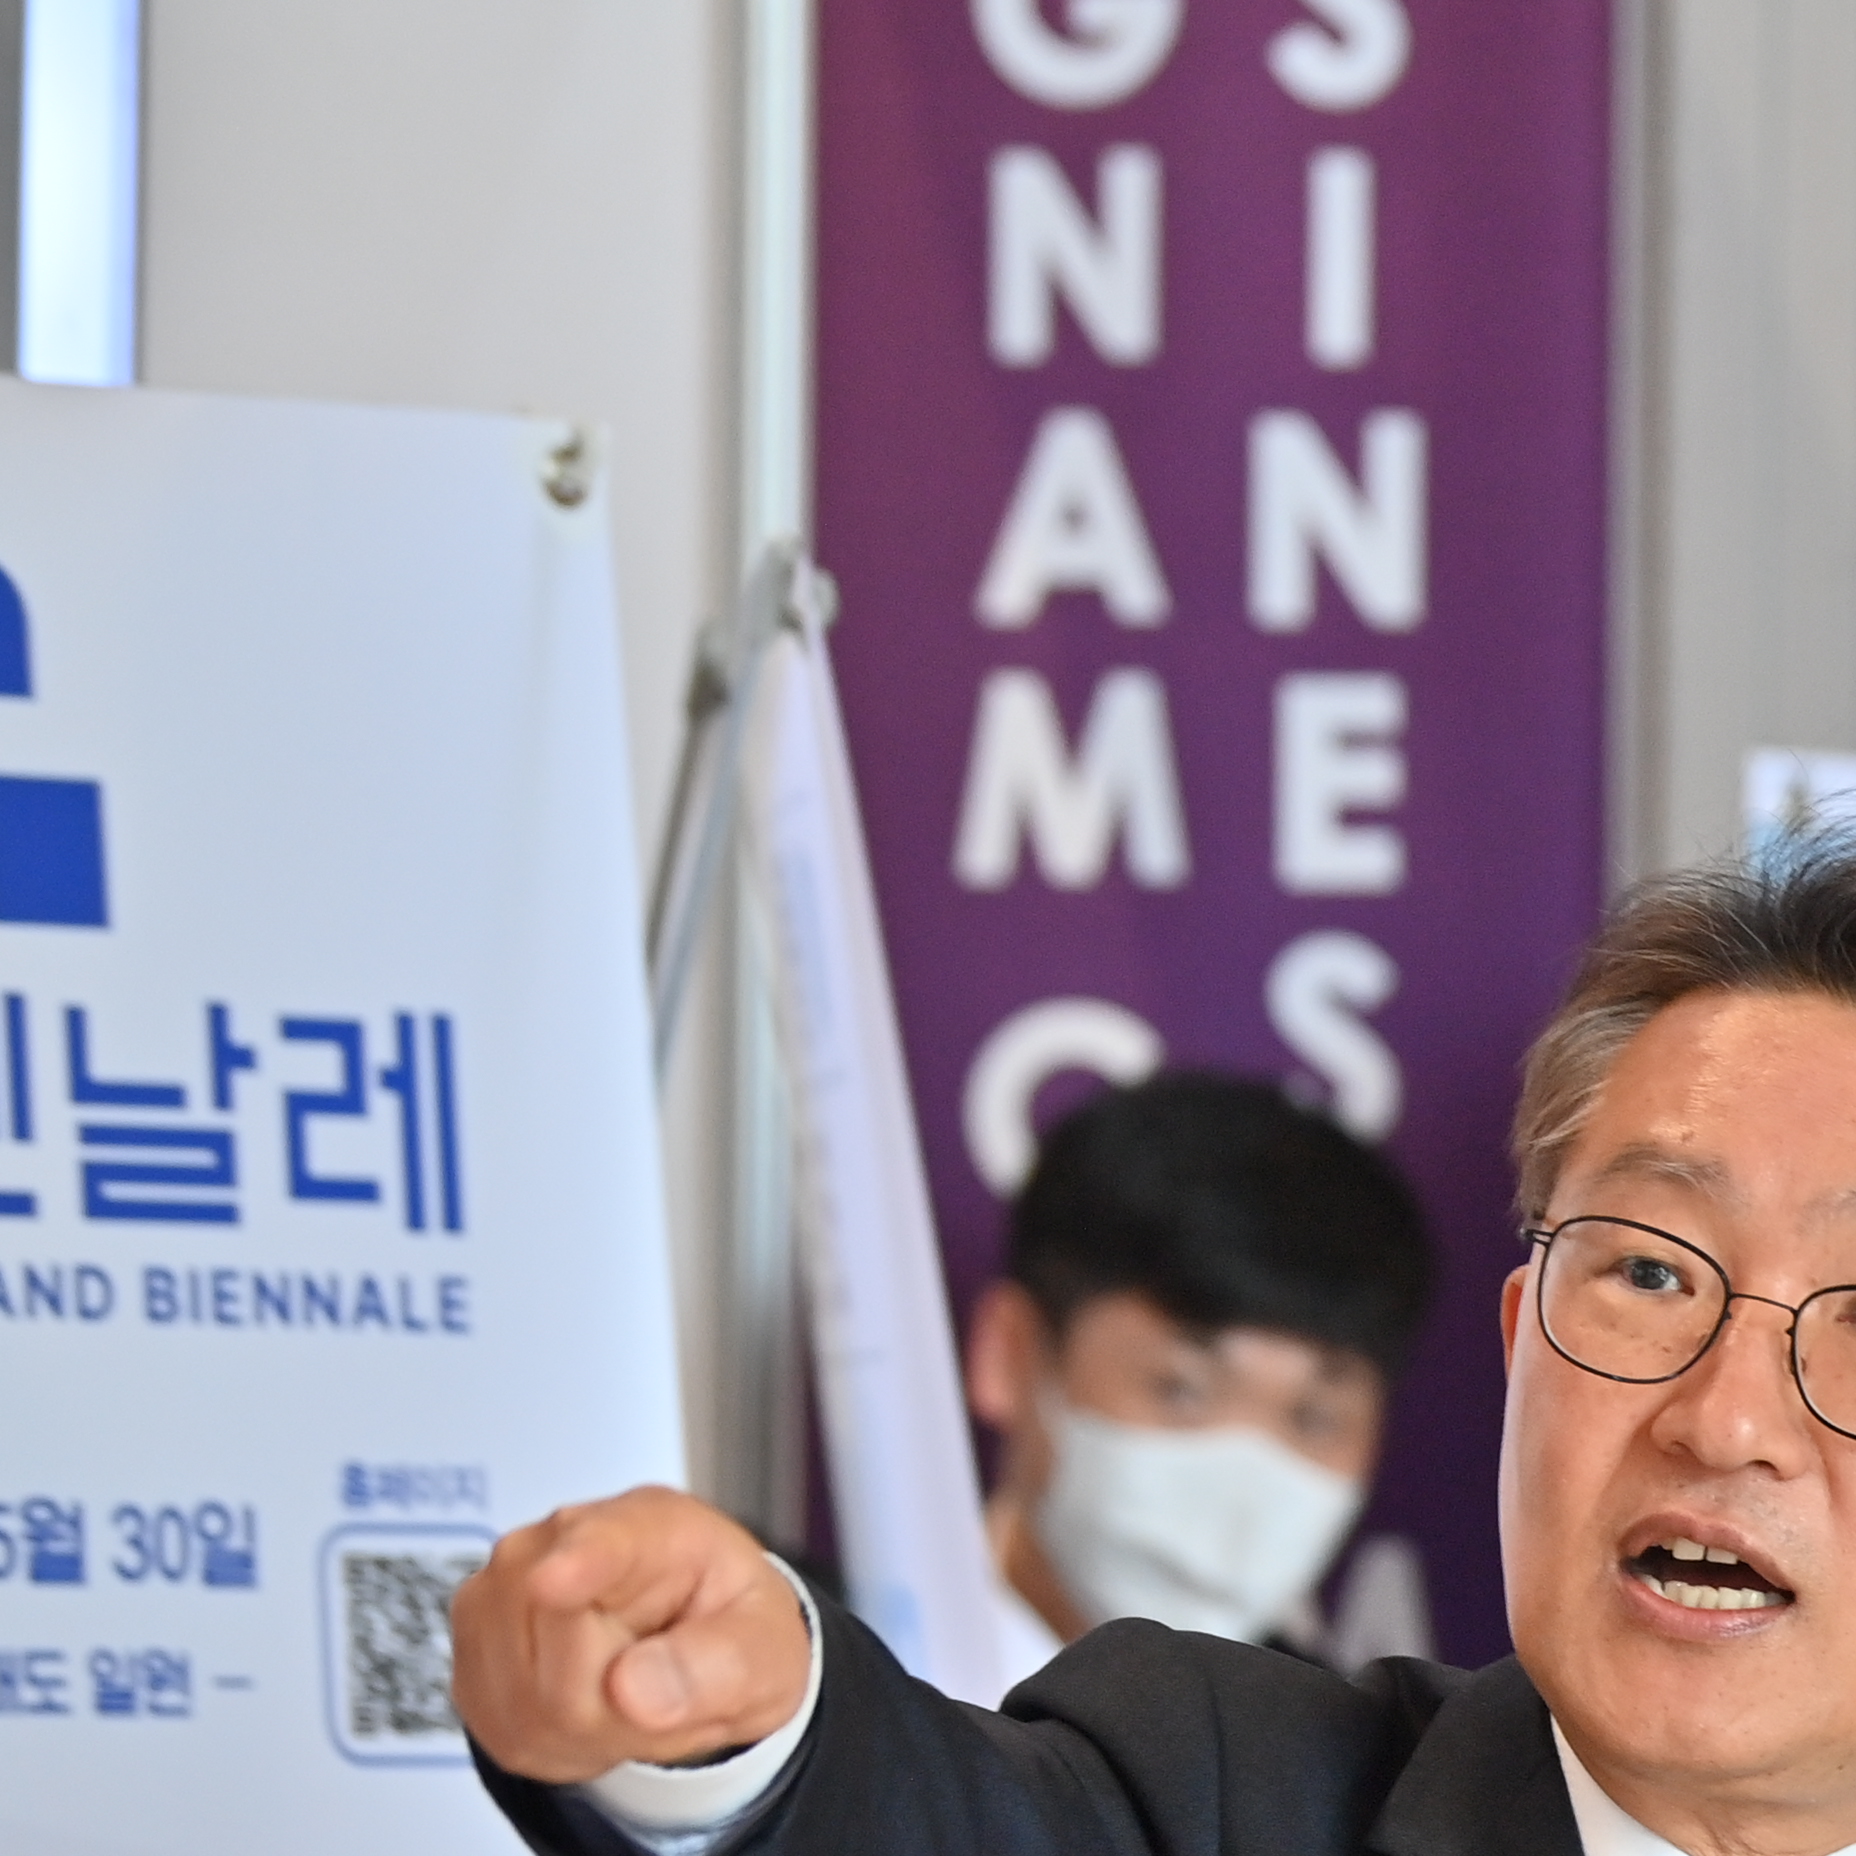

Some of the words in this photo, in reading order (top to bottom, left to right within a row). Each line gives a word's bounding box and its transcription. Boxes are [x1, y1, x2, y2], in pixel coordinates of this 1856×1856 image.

[142, 1264, 472, 1336] BIENNALE
[110, 1500, 258, 1588] 30일
[90, 1649, 191, 1719] 일원
